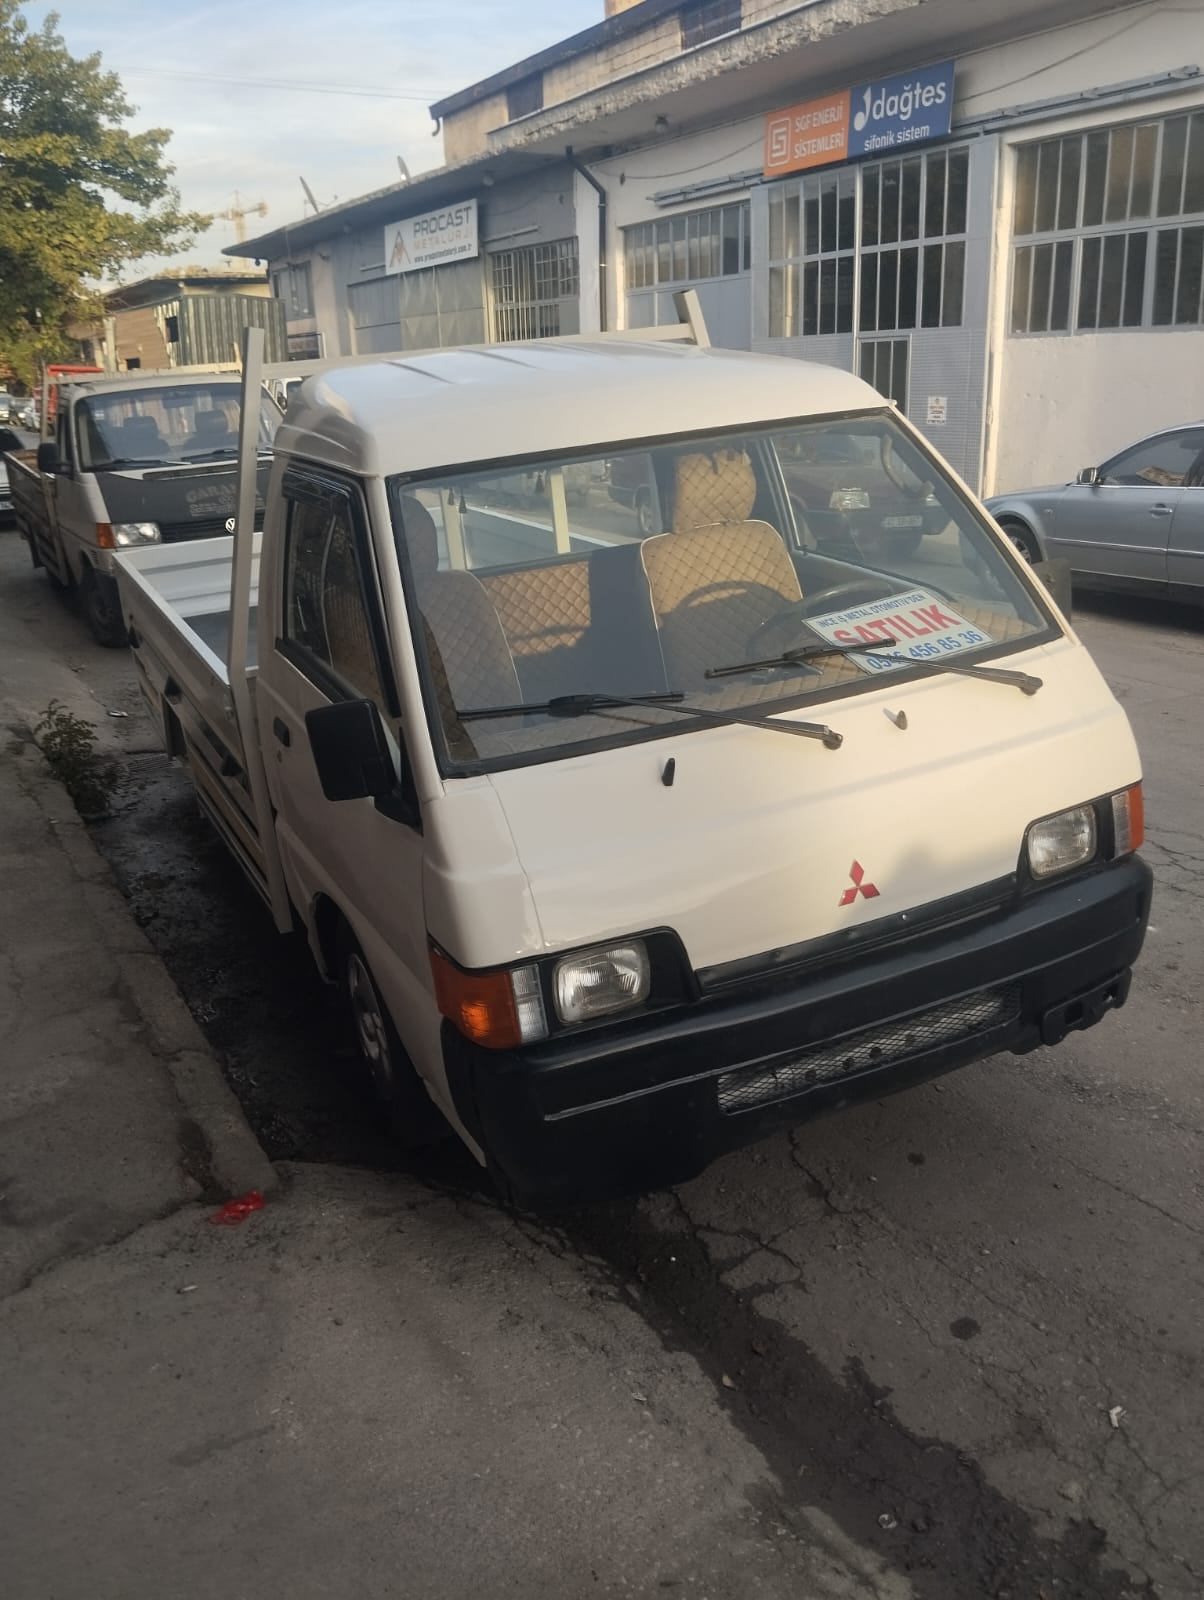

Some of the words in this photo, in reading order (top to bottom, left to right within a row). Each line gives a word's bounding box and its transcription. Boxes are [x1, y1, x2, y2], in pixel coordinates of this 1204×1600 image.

[795, 113, 812, 133] SGF
[812, 101, 844, 128] ENERJİ
[872, 81, 947, 121] dağtes
[793, 128, 846, 160] SİSTEMLERİ
[863, 129, 894, 152] sifonik
[896, 124, 931, 144] sistem
[413, 206, 472, 238] PROCAST
[832, 604, 961, 645] SATILIK
[908, 641, 936, 659] 456
[936, 636, 961, 651] 85
[958, 630, 984, 645] 36
